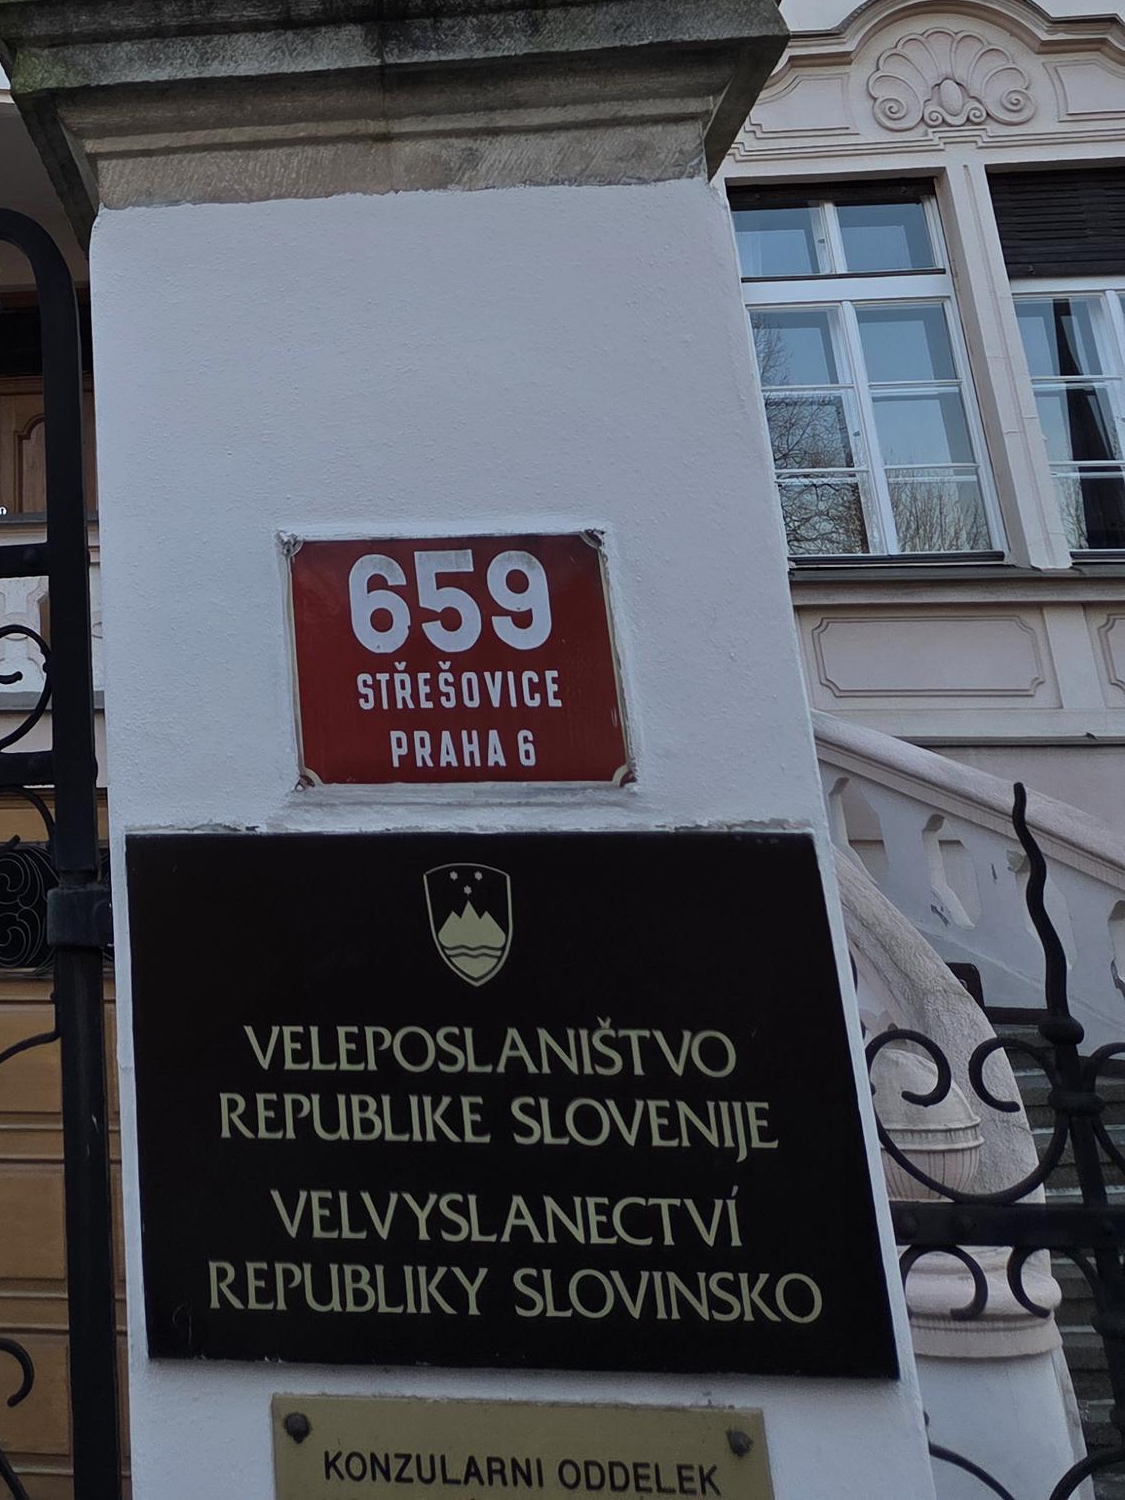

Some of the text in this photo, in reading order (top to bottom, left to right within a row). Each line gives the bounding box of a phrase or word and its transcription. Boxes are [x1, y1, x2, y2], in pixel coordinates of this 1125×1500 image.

[348, 548, 552, 654] 659
[356, 660, 563, 710] STŘEŠOVICE
[389, 729, 536, 768] PRAHA 6
[243, 1016, 737, 1078] VELEPOSLANIŠTVO
[219, 1092, 779, 1163] REPUBLIKE SLOVENIJE
[270, 1185, 743, 1247] VELVYSLANECTVÍ
[208, 1260, 823, 1324] REPUBLIKY SLOVINSKO
[324, 1450, 723, 1497] KONZULARNI ODDELEK
